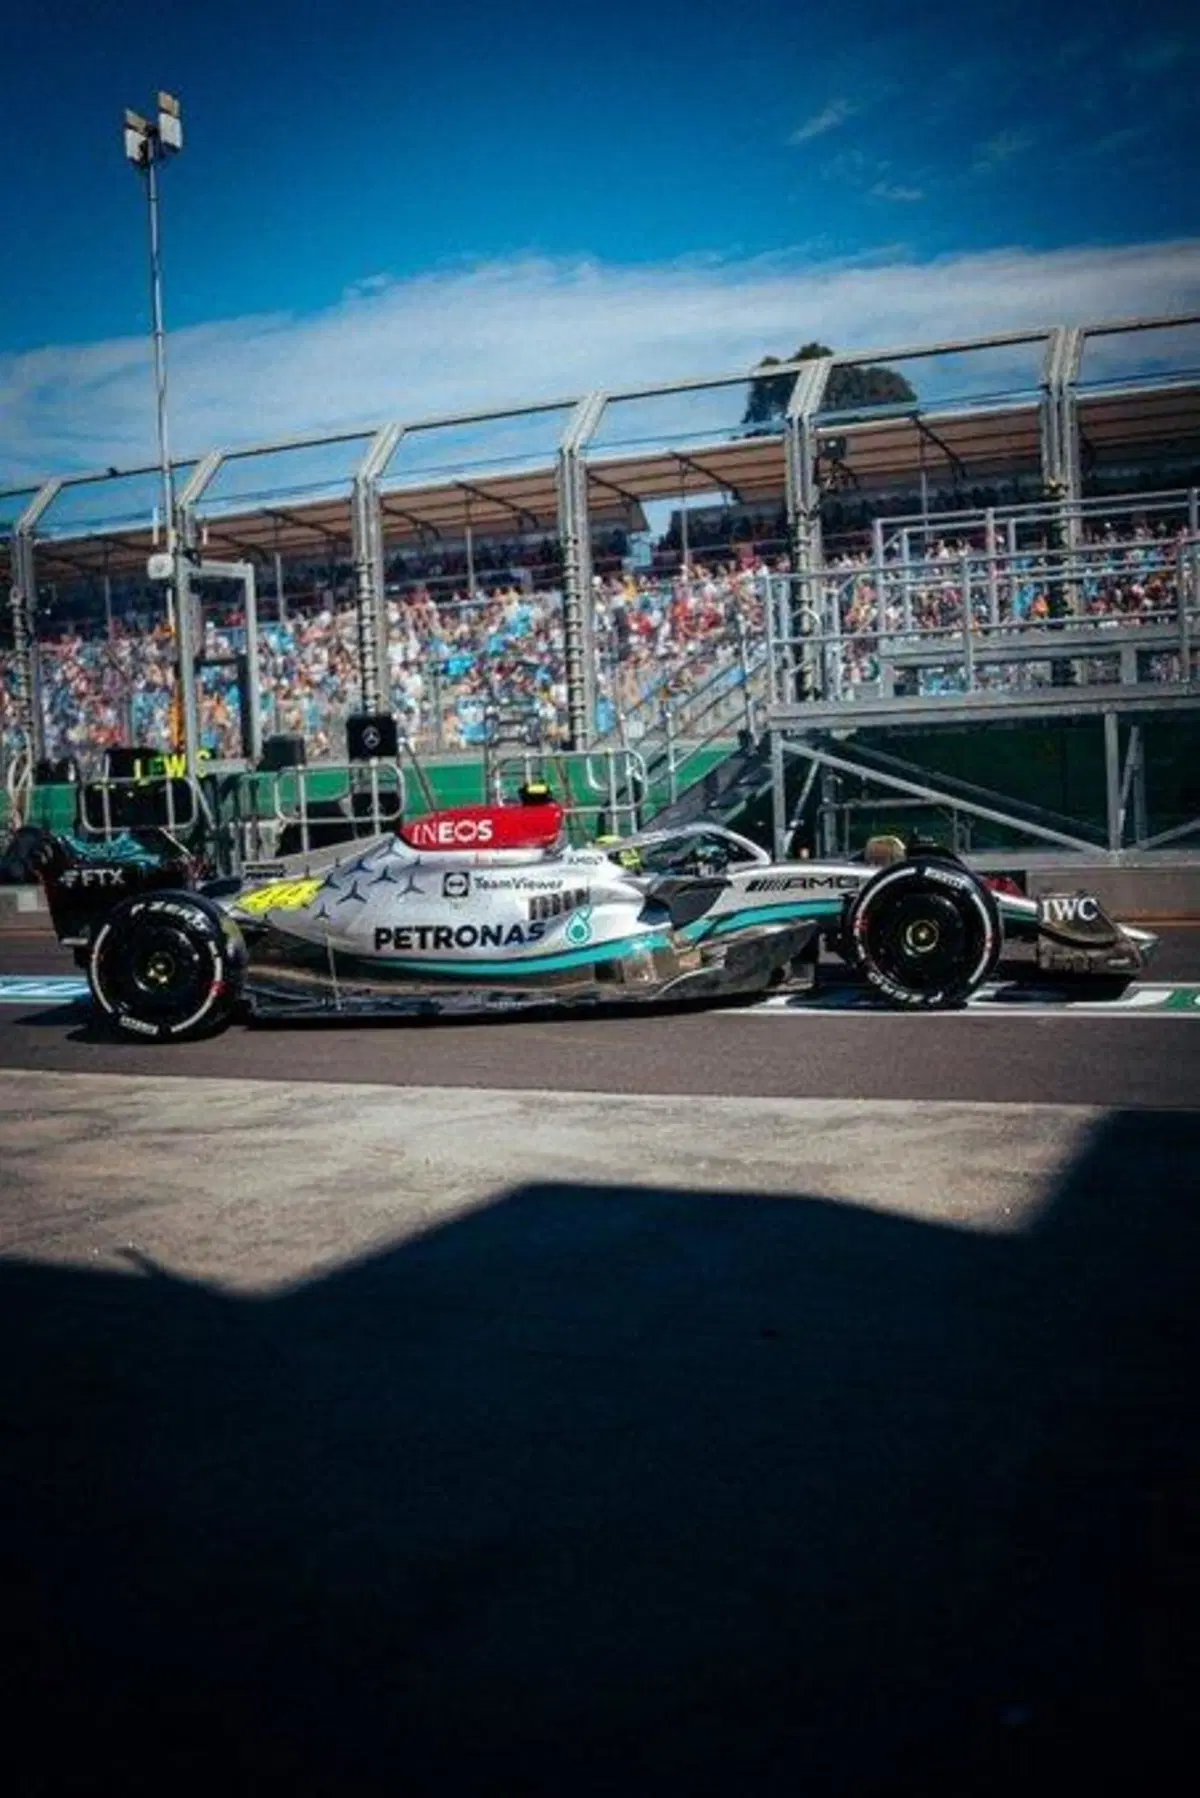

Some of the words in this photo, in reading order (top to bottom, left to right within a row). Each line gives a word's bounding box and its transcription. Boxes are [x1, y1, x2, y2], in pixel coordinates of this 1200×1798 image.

[411, 819, 494, 844] INEOS
[81, 867, 125, 887] FTX
[473, 877, 564, 891] TeamViewer
[783, 876, 860, 891] AMG
[1042, 897, 1098, 922] IWC
[374, 922, 546, 950] PETRONAS
